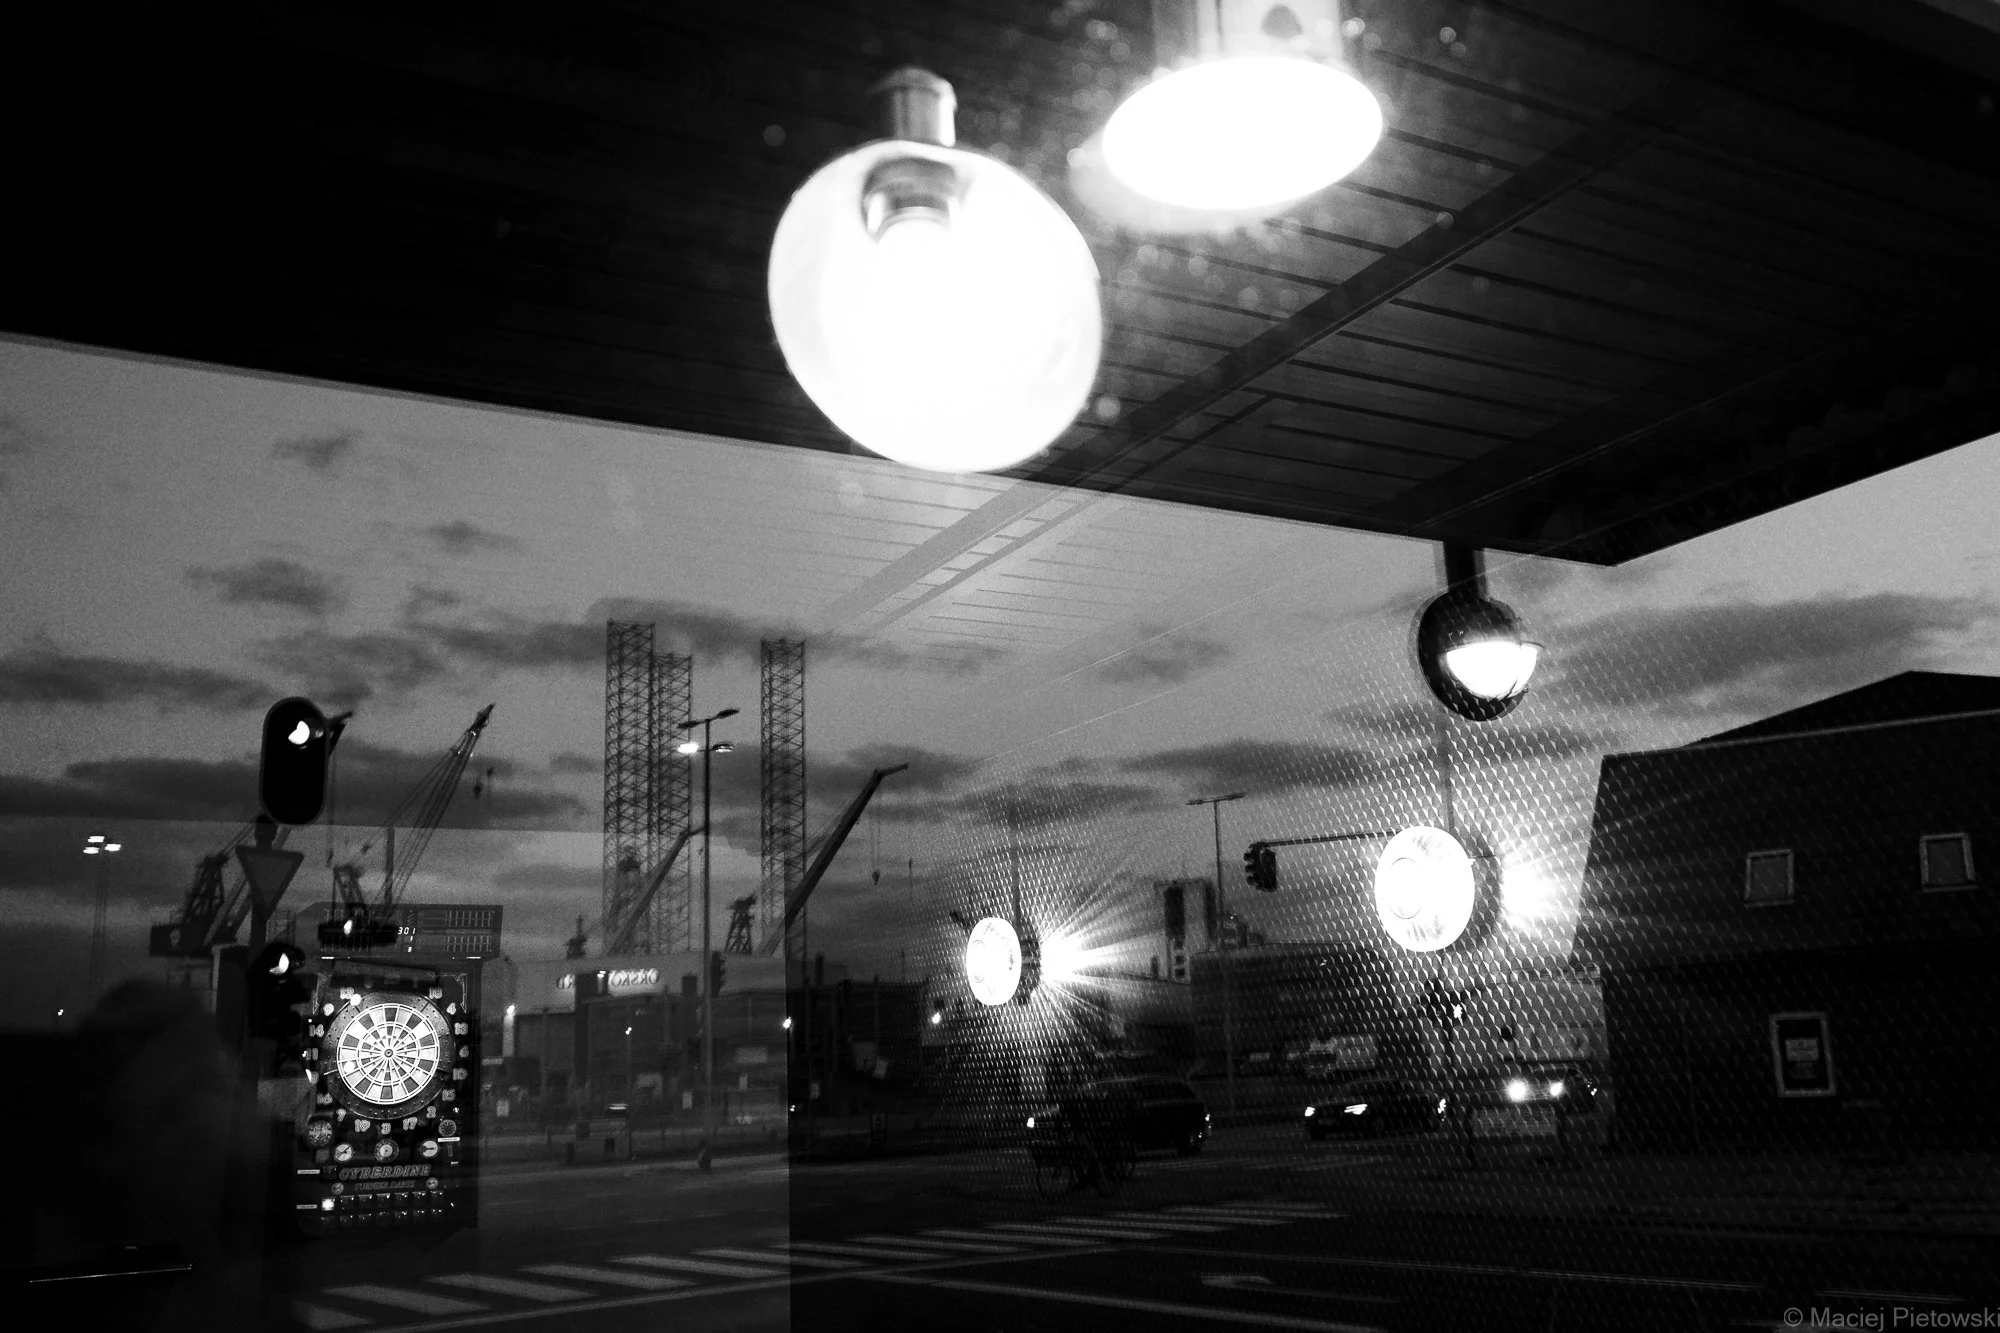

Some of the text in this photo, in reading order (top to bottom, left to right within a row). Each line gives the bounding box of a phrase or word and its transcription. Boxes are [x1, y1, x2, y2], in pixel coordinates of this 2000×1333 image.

[397, 926, 416, 935] 301
[323, 1003, 334, 1016] 9
[447, 1002, 457, 1015] 4
[309, 1024, 324, 1037] 14
[459, 1045, 469, 1058] 6
[336, 1108, 347, 1122] 7
[426, 1106, 437, 1118] 2
[354, 1119, 371, 1132] 19
[381, 1122, 391, 1135] 3
[402, 1117, 418, 1130] 17
[339, 1164, 432, 1181] CYBERDINE
